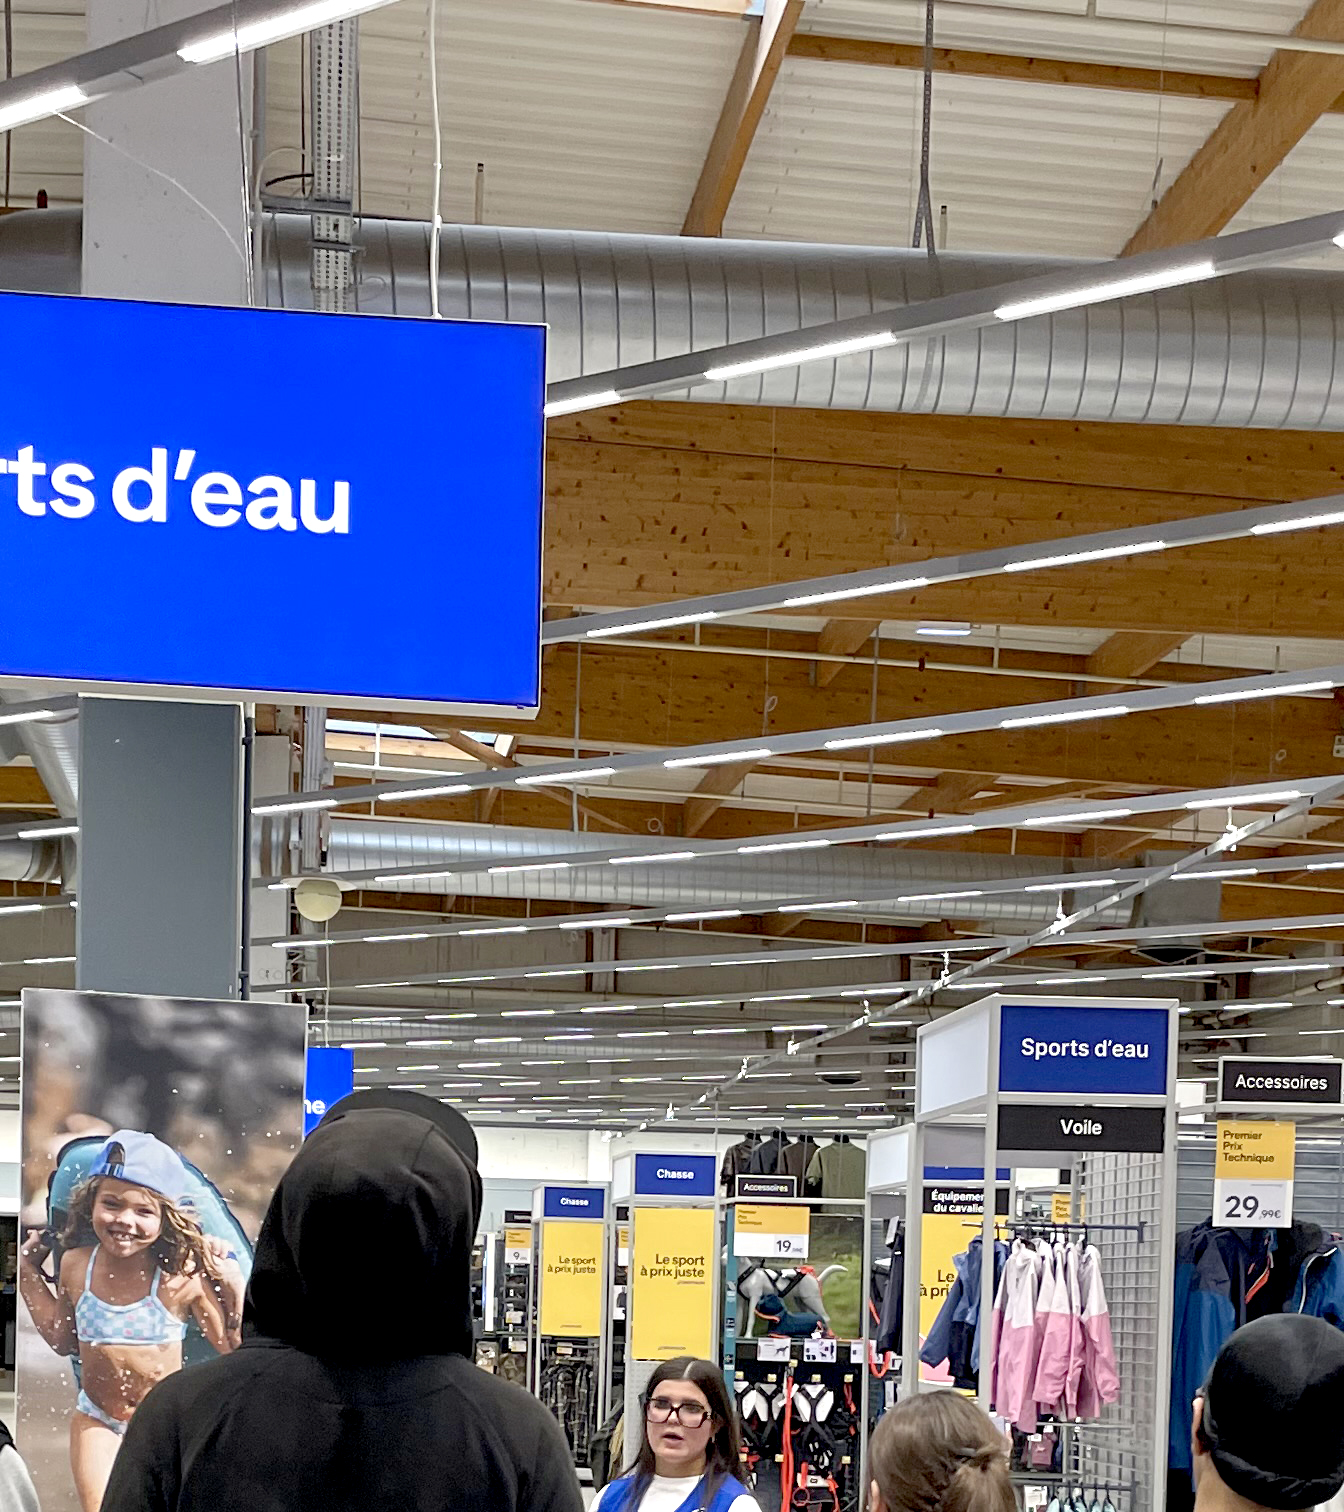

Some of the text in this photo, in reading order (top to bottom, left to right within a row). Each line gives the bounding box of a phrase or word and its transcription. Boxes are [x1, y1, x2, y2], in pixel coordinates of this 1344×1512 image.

[111, 446, 352, 534] d'eau
[1020, 1037, 1150, 1061] Sports d'eau
[1234, 1074, 1329, 1091] Accessoires
[1059, 1118, 1103, 1137] Voile
[1223, 1130, 1263, 1140] Premier
[1223, 1141, 1244, 1151] Prix
[1223, 1152, 1276, 1165] Technique
[656, 1168, 695, 1180] Chasse
[559, 1196, 590, 1207] Chasse
[931, 1188, 984, 1202] Équipeme
[933, 1202, 984, 1213] du cavalie
[558, 1255, 597, 1266] Le sport
[655, 1253, 705, 1268] Le sport
[547, 1263, 596, 1276] à prix juste
[640, 1264, 705, 1280] à prix juste
[937, 1269, 955, 1283] Le
[929, 1283, 950, 1300] pri
